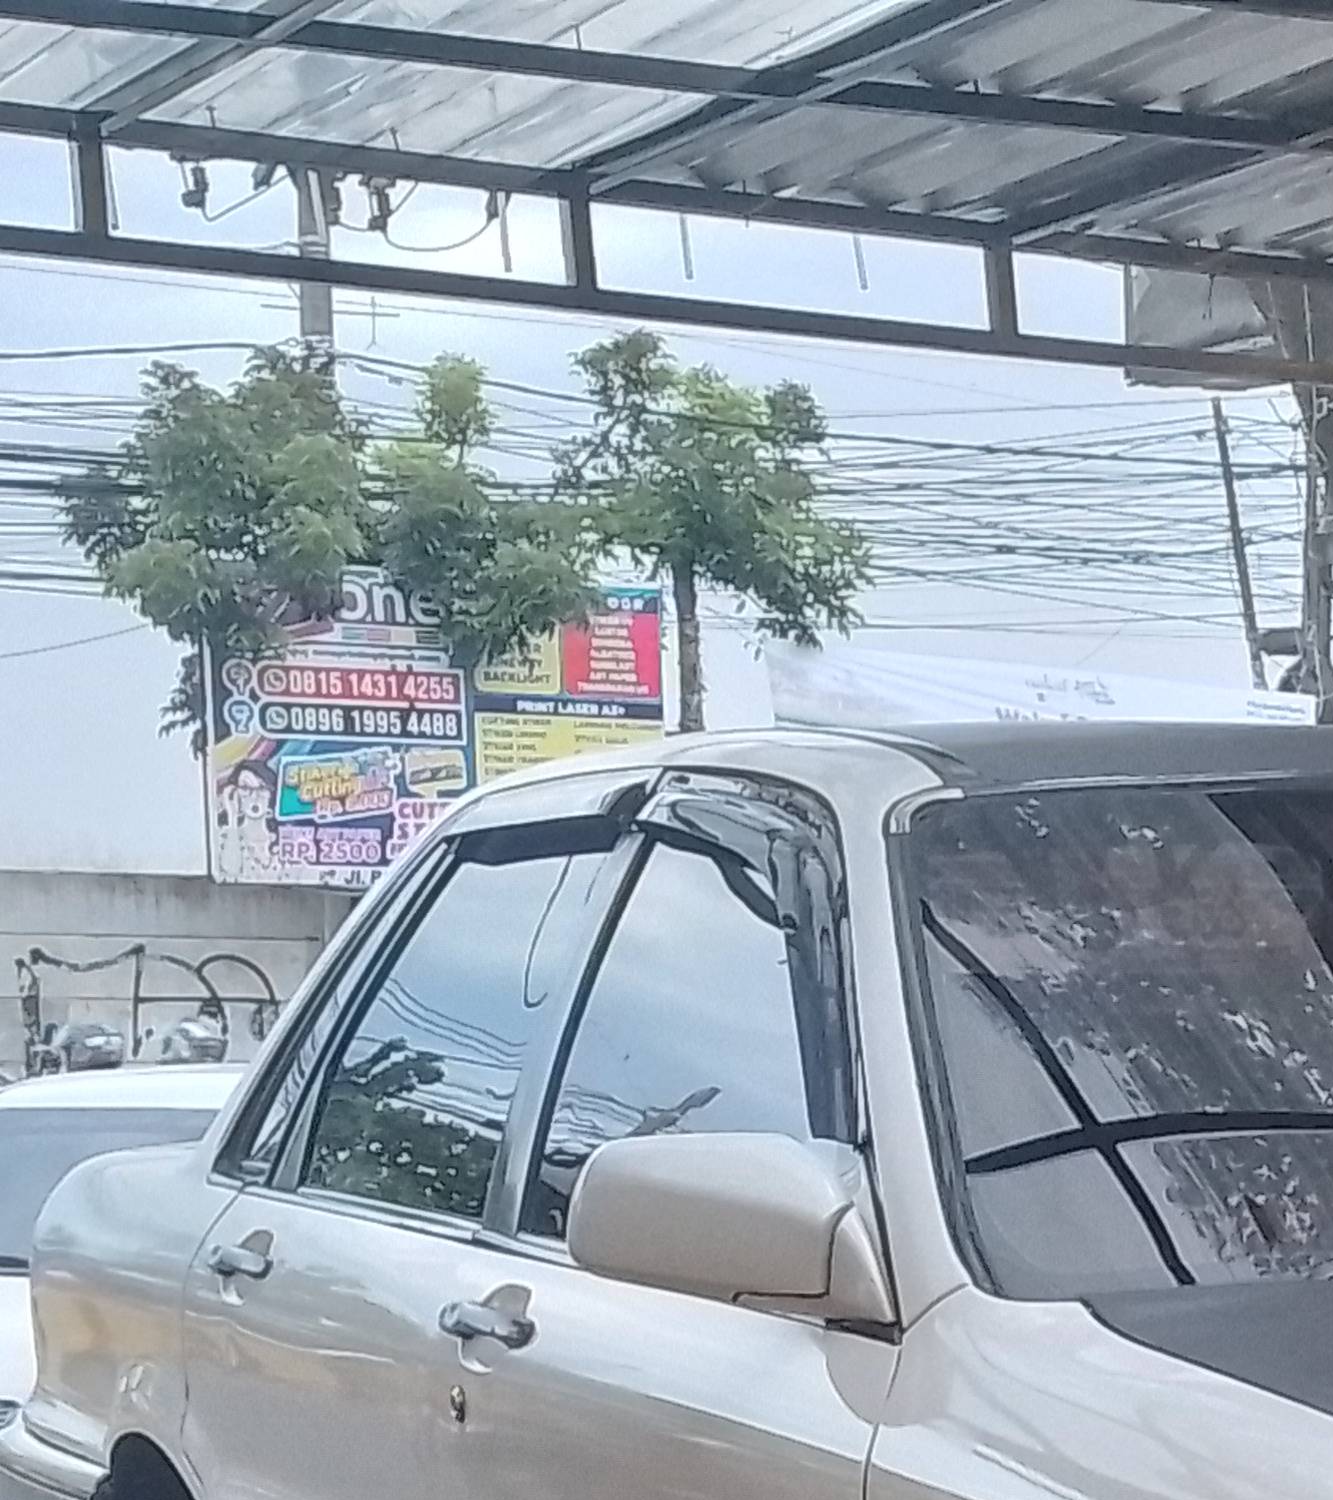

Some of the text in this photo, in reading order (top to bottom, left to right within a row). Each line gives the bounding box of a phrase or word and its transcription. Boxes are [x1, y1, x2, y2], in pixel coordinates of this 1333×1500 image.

[288, 669, 455, 700] 0815 1431 4255
[290, 705, 345, 732] 0896
[351, 708, 401, 735] 1995
[406, 711, 458, 738] 4488
[322, 841, 379, 861] 2500
